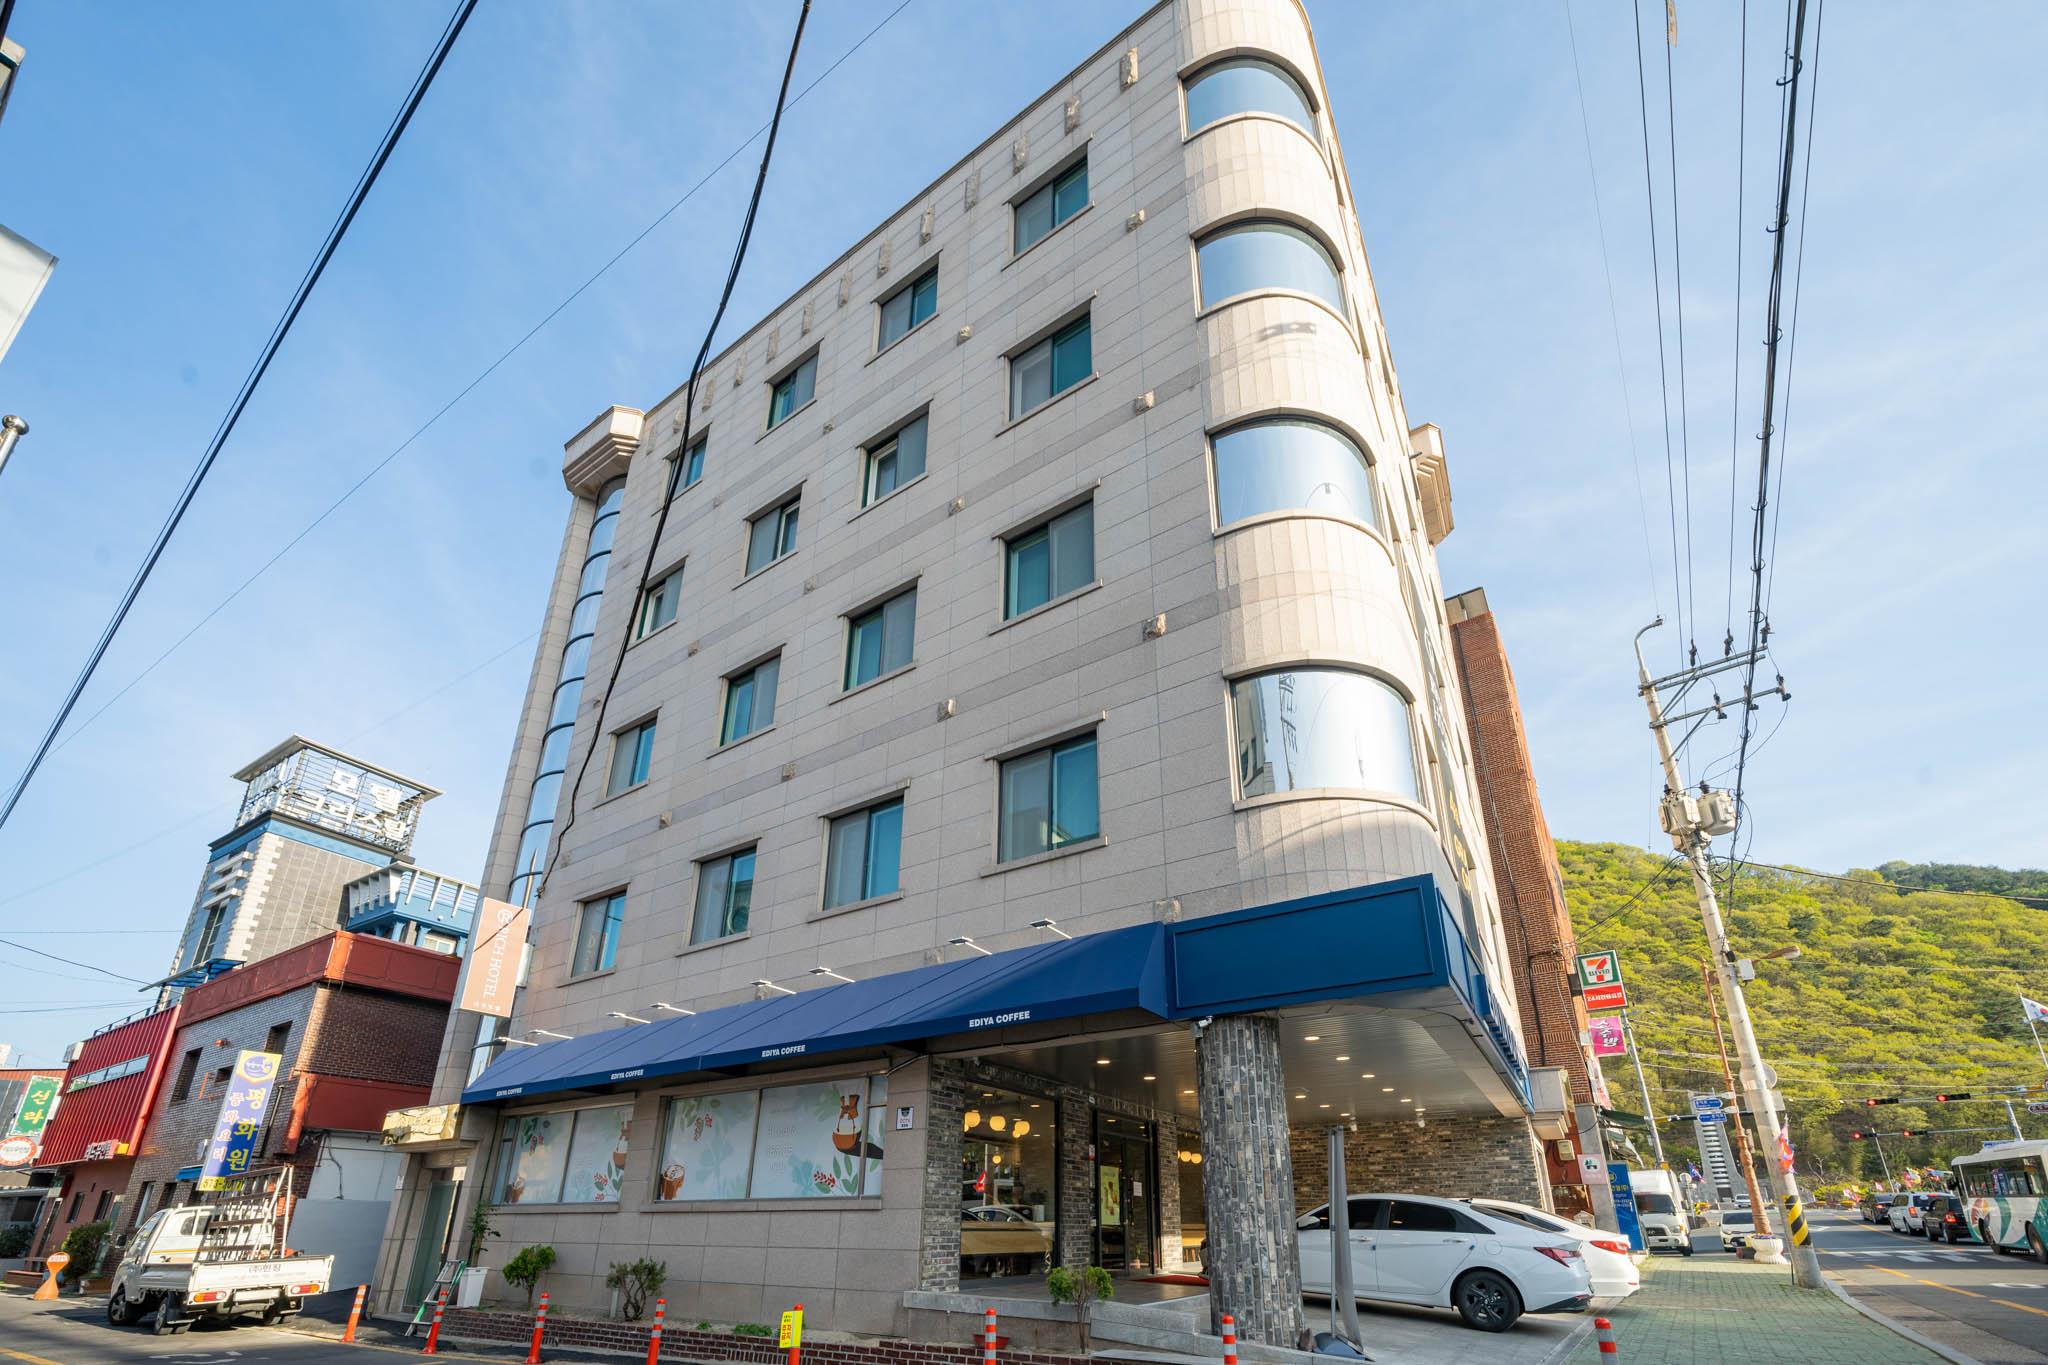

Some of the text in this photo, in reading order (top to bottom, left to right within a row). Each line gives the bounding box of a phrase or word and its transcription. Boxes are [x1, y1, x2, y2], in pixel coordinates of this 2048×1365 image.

[325, 769, 402, 814] 모텔
[492, 925, 510, 956] RICH
[483, 957, 503, 999] HOTEL
[1586, 957, 1608, 982] 7
[969, 1010, 1030, 1028] EDIYA COFFEE
[761, 1044, 806, 1058] EDIYA COFFEE
[625, 1069, 644, 1078] COFFEE
[24, 1090, 52, 1124] 신라
[226, 1088, 266, 1171] 평화원
